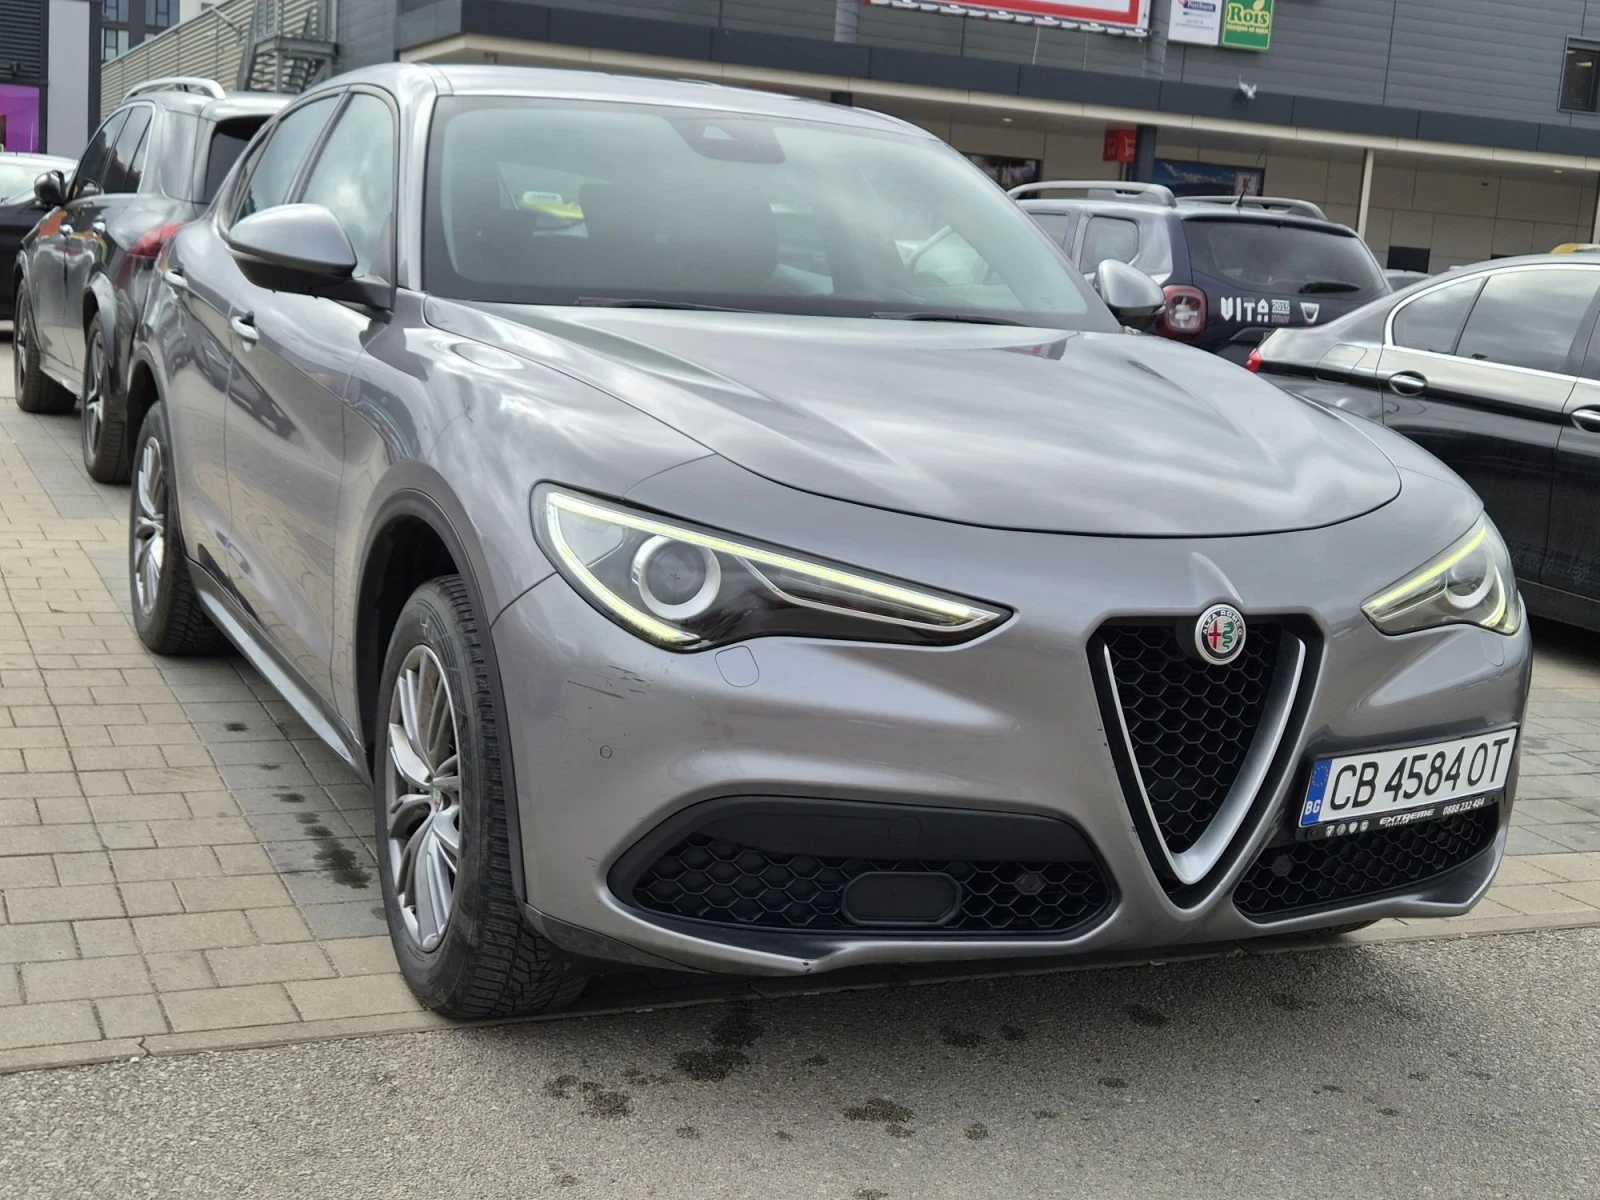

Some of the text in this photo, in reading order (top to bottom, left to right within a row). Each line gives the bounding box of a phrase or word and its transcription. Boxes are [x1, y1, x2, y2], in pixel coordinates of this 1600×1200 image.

[1228, 3, 1270, 26] Rois
[1220, 296, 1269, 323] VITA
[1203, 611, 1243, 636] ALFA ROMEO
[1330, 761, 1379, 811] CB
[1384, 746, 1466, 803] 4584
[1304, 799, 1321, 815] BG
[1379, 808, 1435, 826] EXTREME
